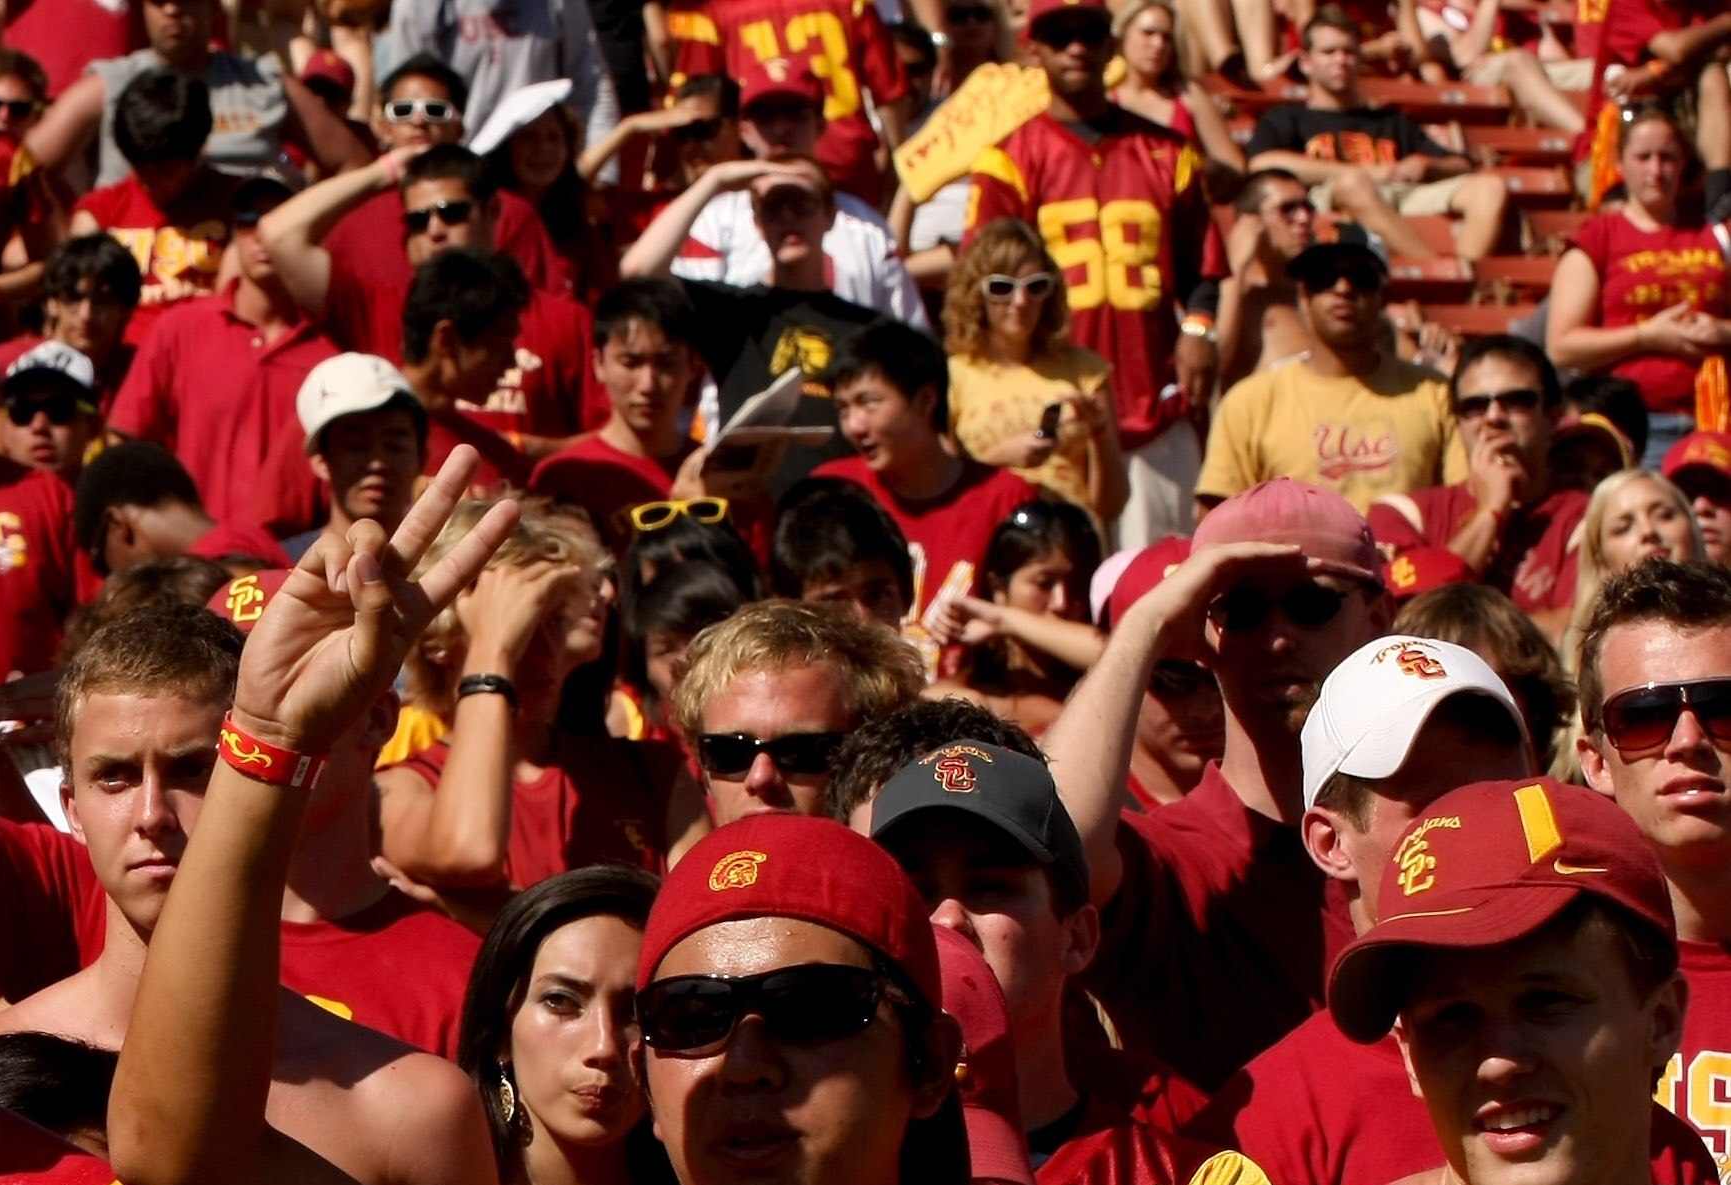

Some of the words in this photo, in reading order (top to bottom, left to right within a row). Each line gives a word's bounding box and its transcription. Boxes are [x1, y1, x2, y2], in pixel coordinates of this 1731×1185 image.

[225, 574, 265, 622] SC
[1396, 650, 1447, 680] SC
[1397, 840, 1436, 896] SC
